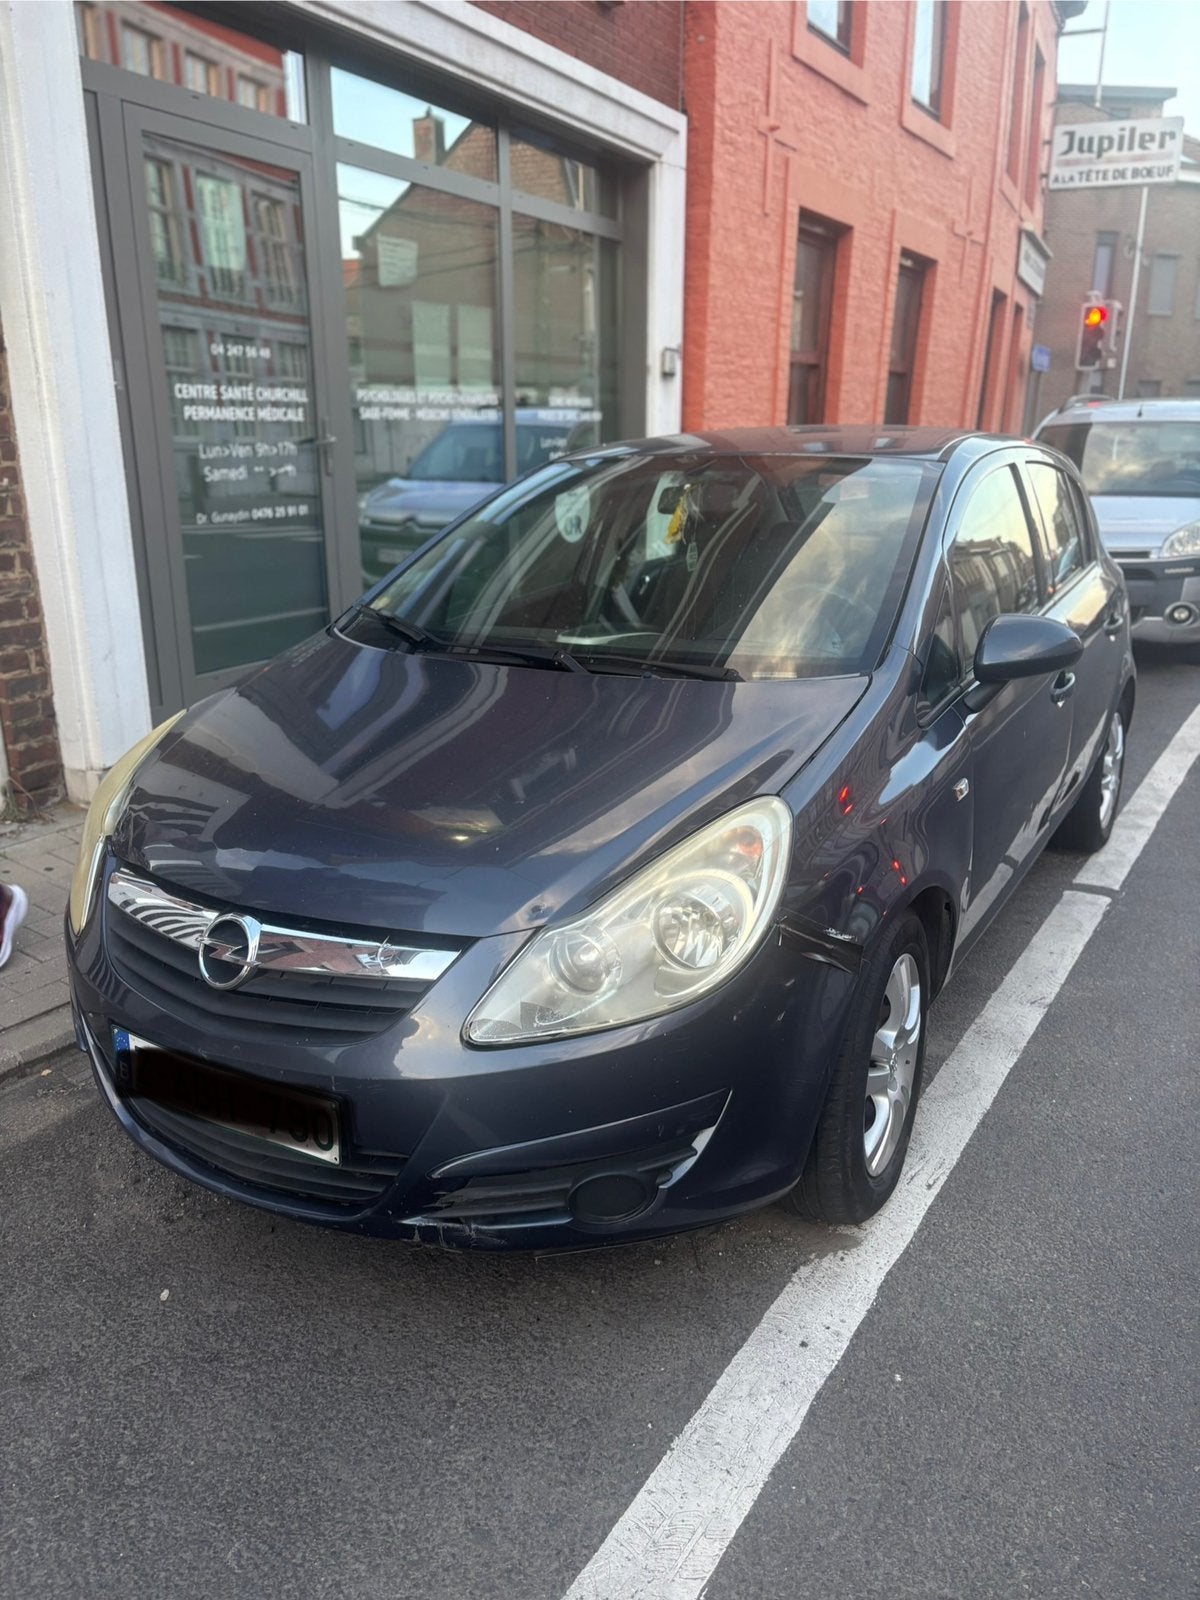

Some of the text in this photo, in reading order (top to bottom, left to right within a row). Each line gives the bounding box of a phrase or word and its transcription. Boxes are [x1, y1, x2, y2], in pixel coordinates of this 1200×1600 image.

[1058, 126, 1177, 159] Jupiler
[1077, 167, 1109, 183] TÊTE
[1111, 167, 1128, 181] DE
[174, 382, 309, 403] CENTRE SANTÉ CHURCHILL
[183, 403, 305, 423] PERMANENCE MÉDICALE
[203, 465, 248, 482] Samedi
